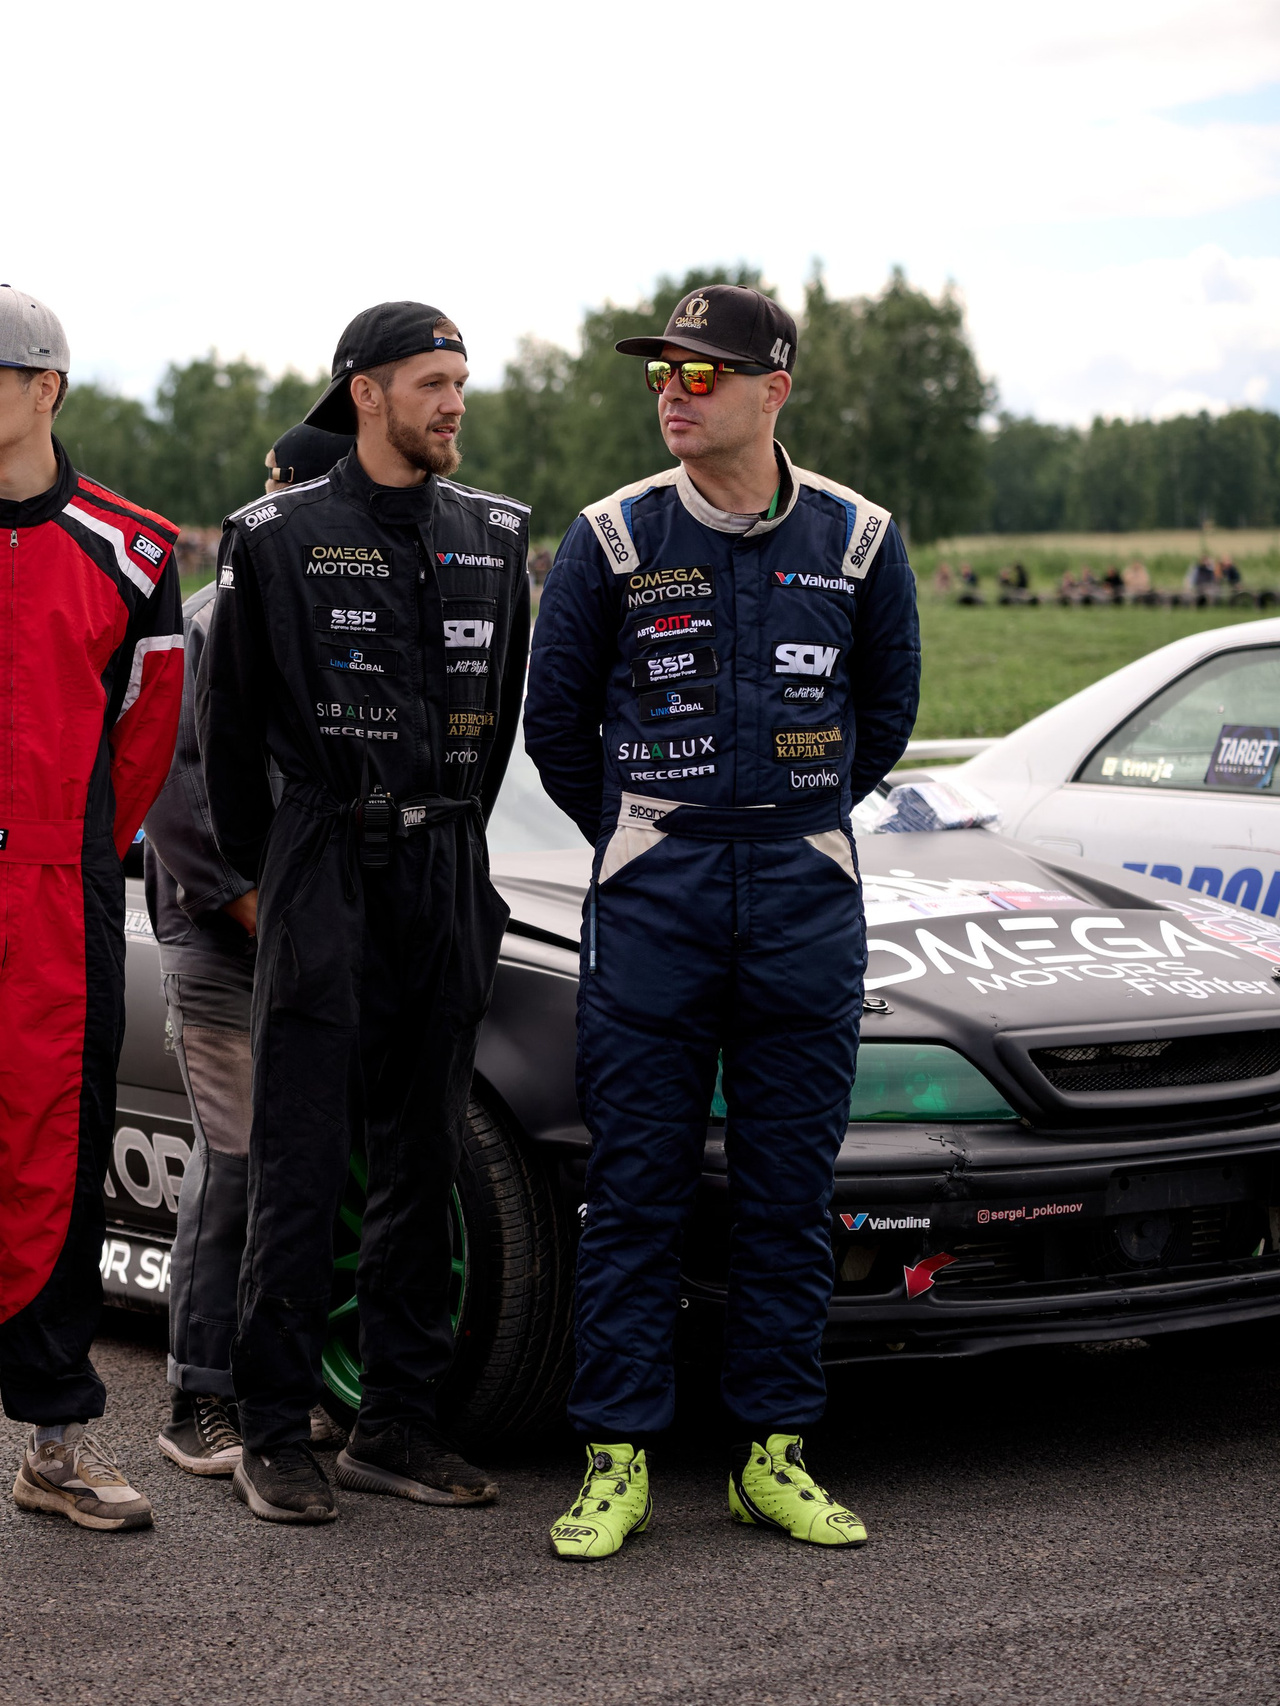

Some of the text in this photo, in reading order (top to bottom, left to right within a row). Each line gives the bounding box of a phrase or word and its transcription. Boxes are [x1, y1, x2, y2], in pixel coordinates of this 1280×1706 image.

[675, 317, 707, 326] OMEGA
[770, 338, 791, 369] 44
[245, 505, 278, 527] OMP
[489, 511, 520, 530] OMP
[595, 513, 629, 562] sparco
[850, 516, 882, 568] sparco
[135, 539, 162, 560] OMP
[312, 547, 383, 561] OMEGA
[306, 562, 390, 577] MOTORS
[630, 568, 705, 589] OMEGA
[628, 583, 712, 608] MOTORS
[331, 609, 377, 625] SSP
[443, 620, 494, 648] SCW
[651, 628, 698, 639] НОВОСИБИРСК
[648, 653, 694, 676] SSP
[775, 643, 840, 677] SCW
[320, 726, 398, 740] RECERA
[775, 727, 842, 745] СИБИРСКИЙ
[1218, 738, 1279, 767] TARGET
[630, 765, 715, 781] RECERA
[791, 769, 839, 788] bronko
[403, 809, 426, 825] OMP
[629, 804, 666, 819] sparc
[966, 961, 1204, 994] MOTORS
[1126, 977, 1275, 999] Fighter
[991, 1203, 1083, 1221] sergei_poklonov
[869, 1217, 930, 1230] Valvoline
